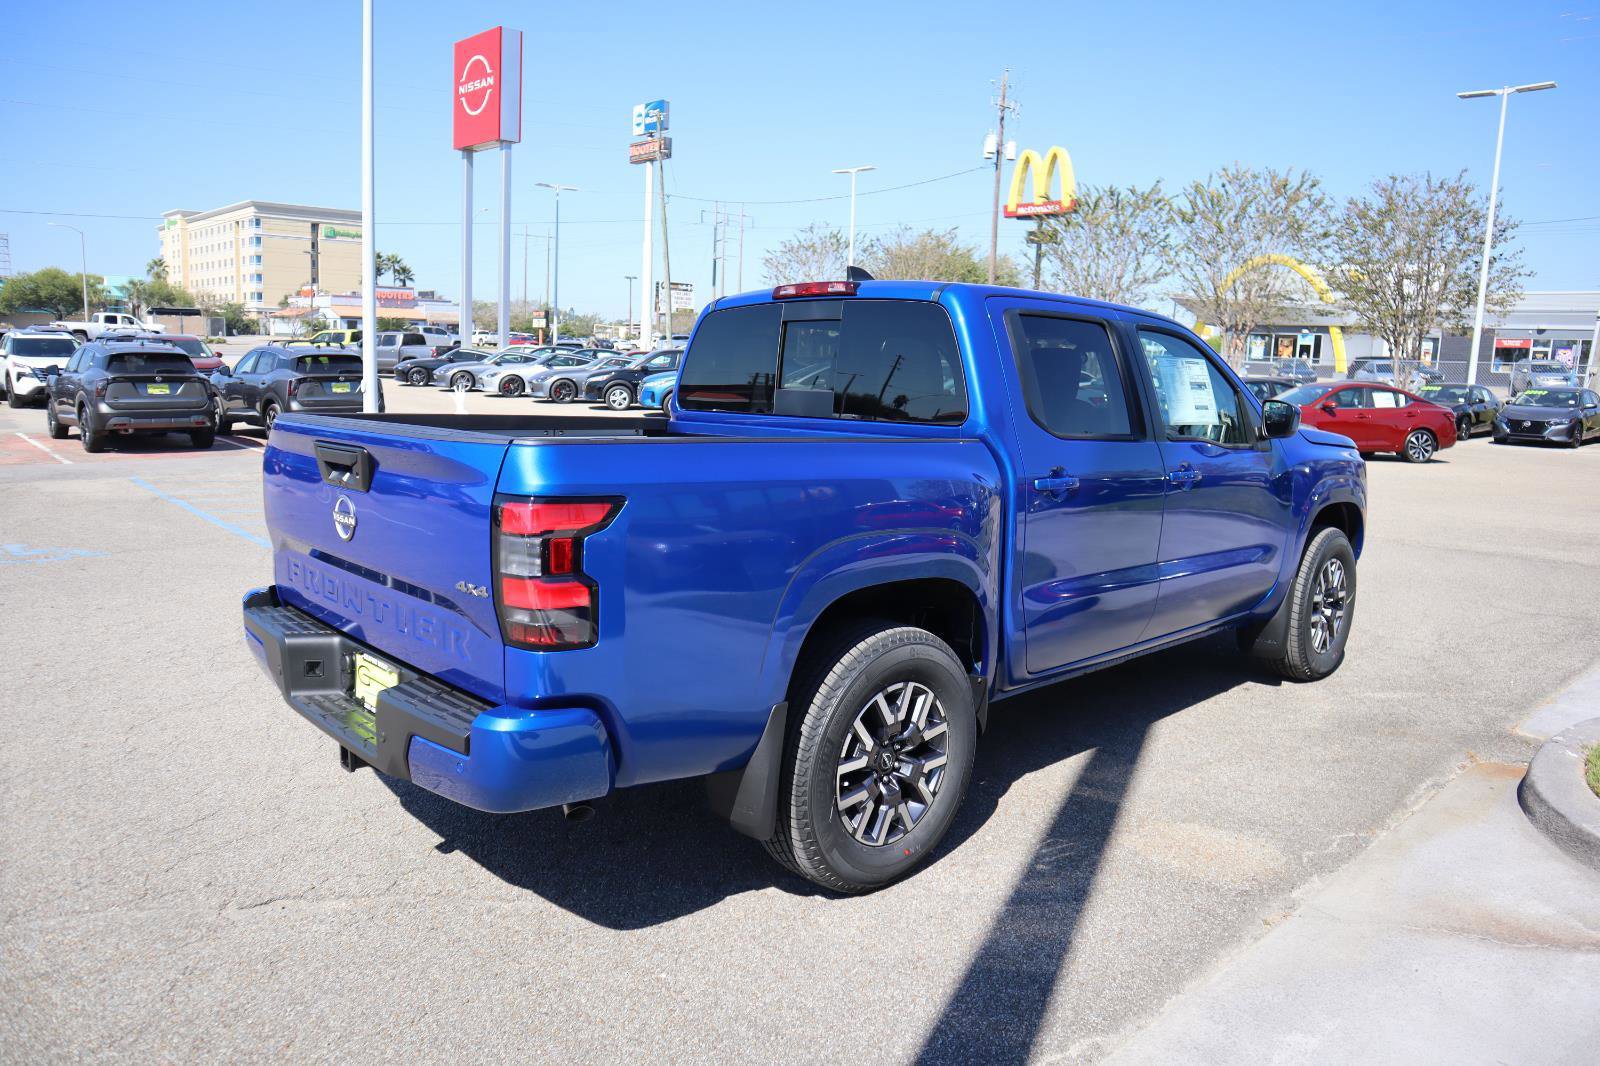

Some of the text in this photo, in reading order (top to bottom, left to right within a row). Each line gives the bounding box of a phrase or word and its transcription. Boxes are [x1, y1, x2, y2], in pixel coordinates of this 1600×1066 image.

[458, 76, 494, 95] NISSAN
[1017, 204, 1060, 215] McDonald's
[333, 511, 355, 527] NISSAN
[287, 557, 472, 662] FRONTIER
